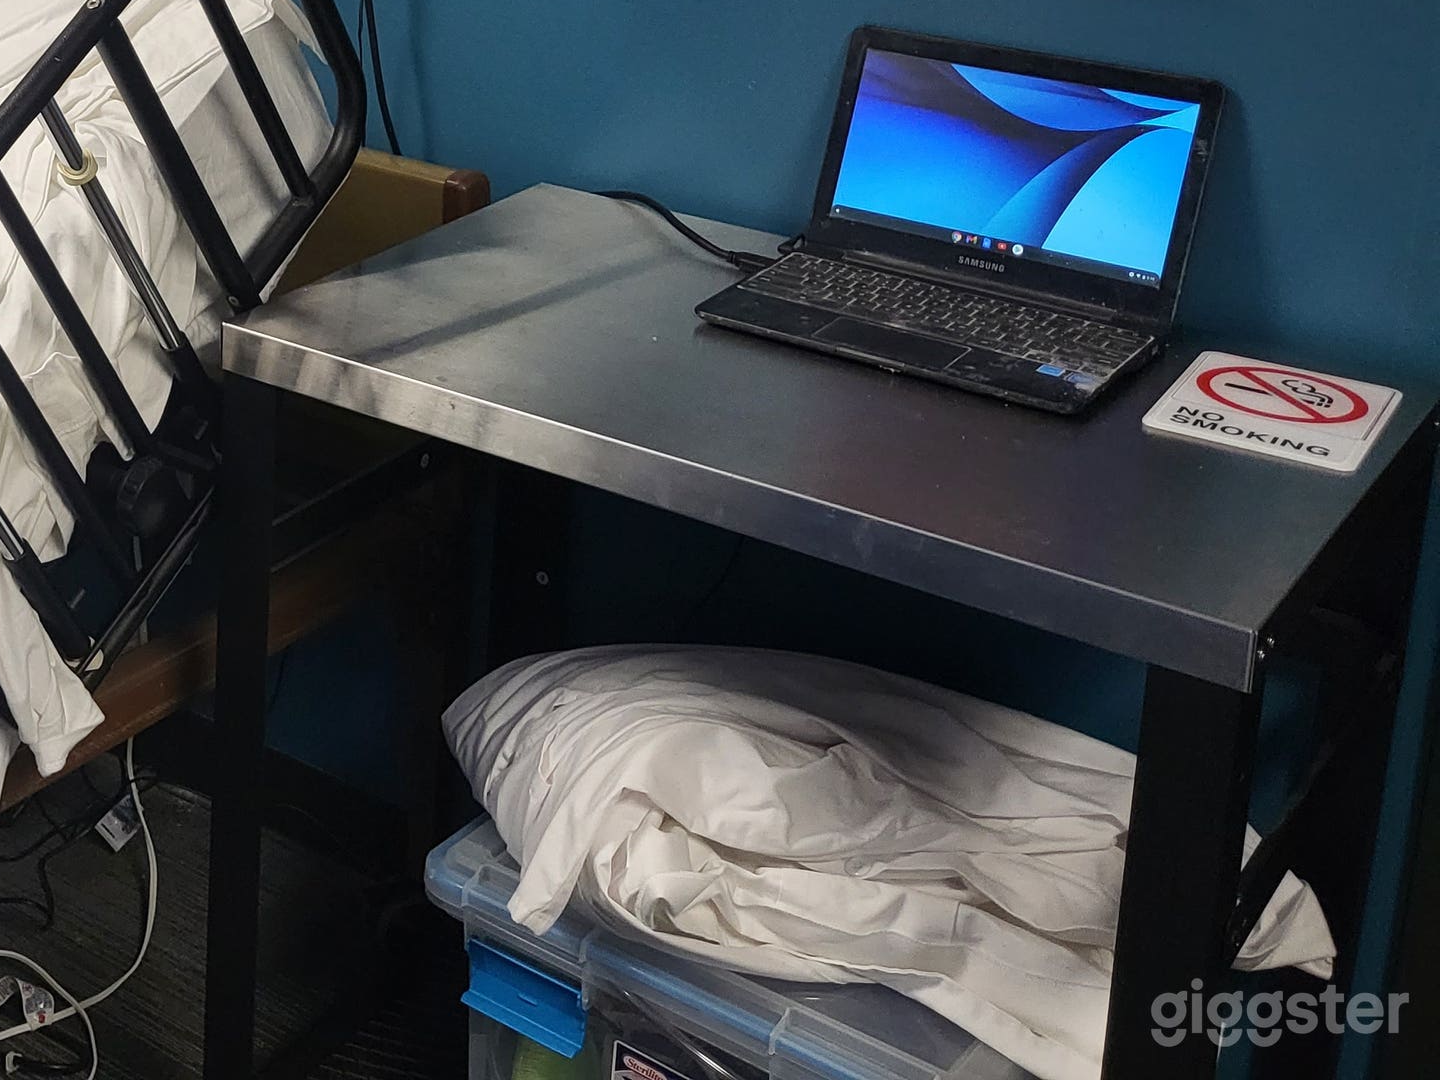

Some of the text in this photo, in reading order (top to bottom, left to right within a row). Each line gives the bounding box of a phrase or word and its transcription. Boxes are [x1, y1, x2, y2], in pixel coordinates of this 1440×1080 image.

[958, 255, 1006, 273] SAMSUNG
[1176, 405, 1225, 422] NO
[1169, 413, 1331, 457] SMOKING
